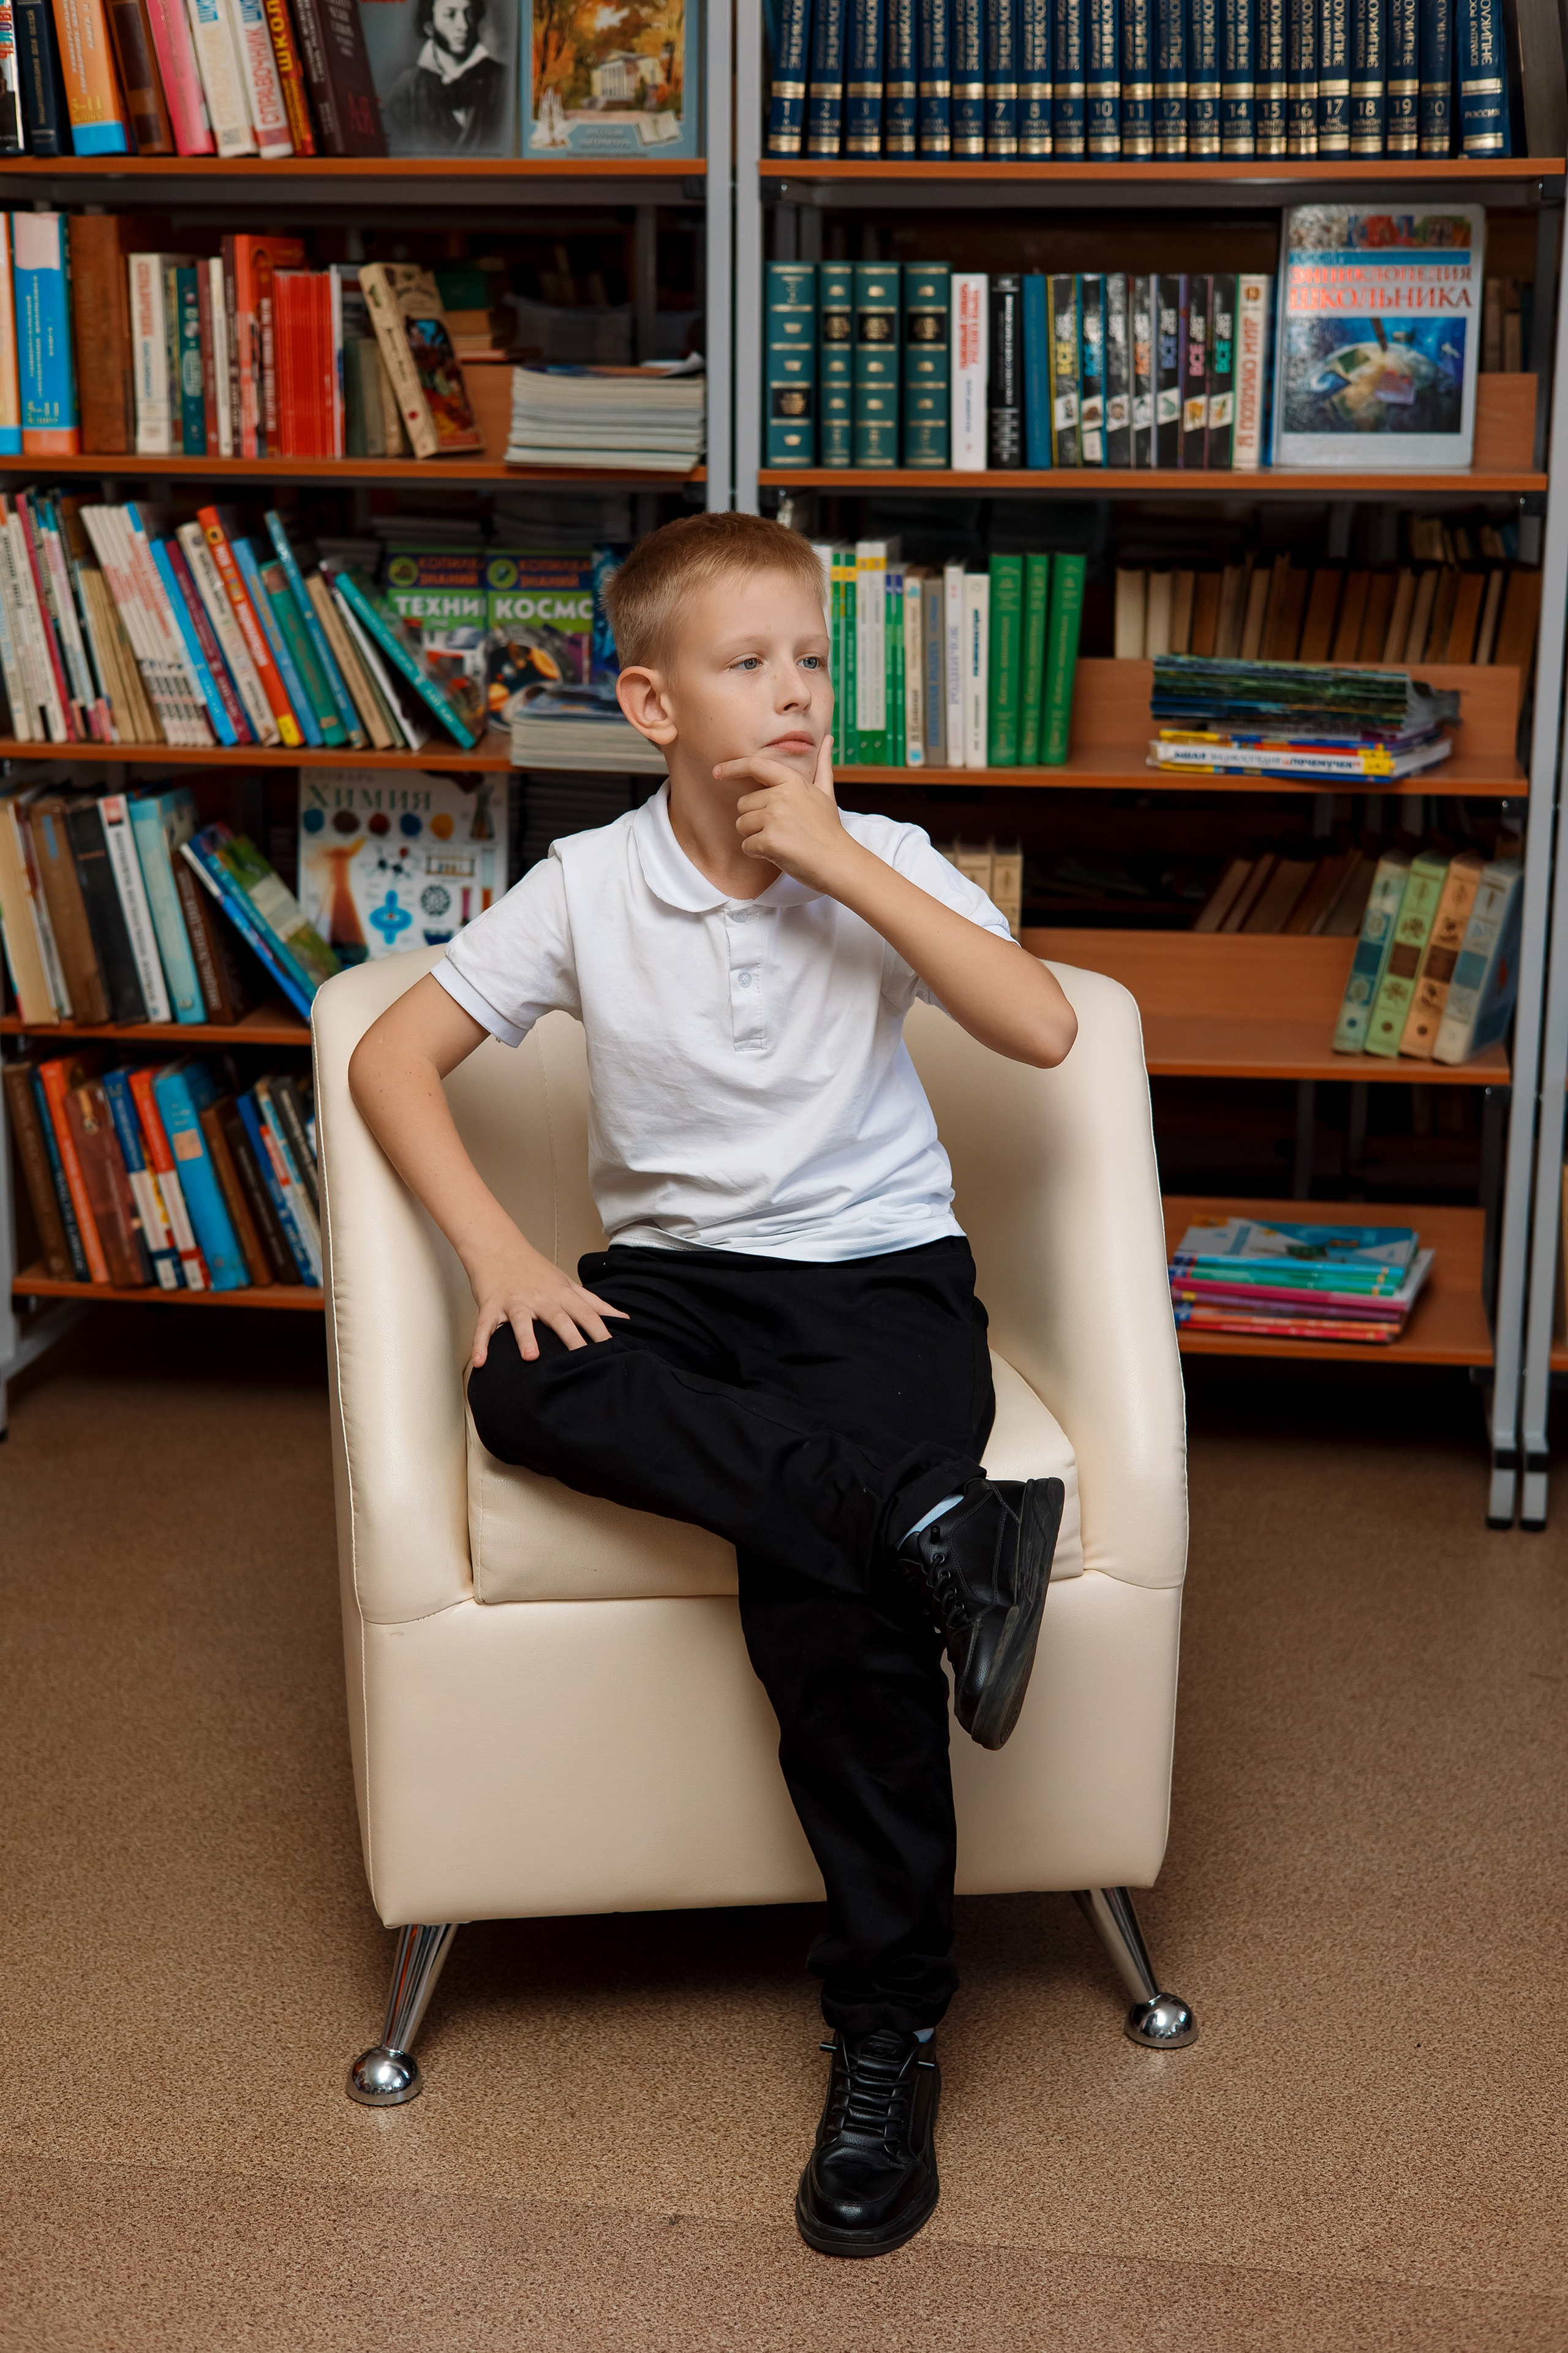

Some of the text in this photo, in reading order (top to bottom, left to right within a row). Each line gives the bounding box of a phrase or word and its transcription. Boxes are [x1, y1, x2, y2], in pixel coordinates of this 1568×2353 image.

[246, 25, 280, 125] СПРАВОЧНИК
[782, 100, 790, 116] 1
[820, 102, 830, 118] 2
[894, 102, 905, 115] 4
[995, 102, 1006, 118] 7
[1030, 102, 1041, 118] 8
[1063, 103, 1073, 117] 9
[1094, 100, 1112, 118] 10
[1127, 103, 1144, 118] 11
[1164, 101, 1180, 118] 12
[1195, 101, 1213, 118] 13
[1228, 102, 1248, 118] 14
[1262, 102, 1280, 118] 15
[1295, 102, 1313, 118] 16
[1325, 99, 1344, 115] 17
[1358, 100, 1376, 116] 18
[1393, 99, 1412, 115] 19
[1291, 266, 1471, 284] ЭНЦИКЛОПЕДИЯ
[1289, 287, 1471, 310] ШКОЛЬНИКА
[1243, 317, 1258, 353] МИР
[1240, 360, 1257, 429] ПОЗНАЮ
[306, 784, 431, 811] ХИМИЯ
